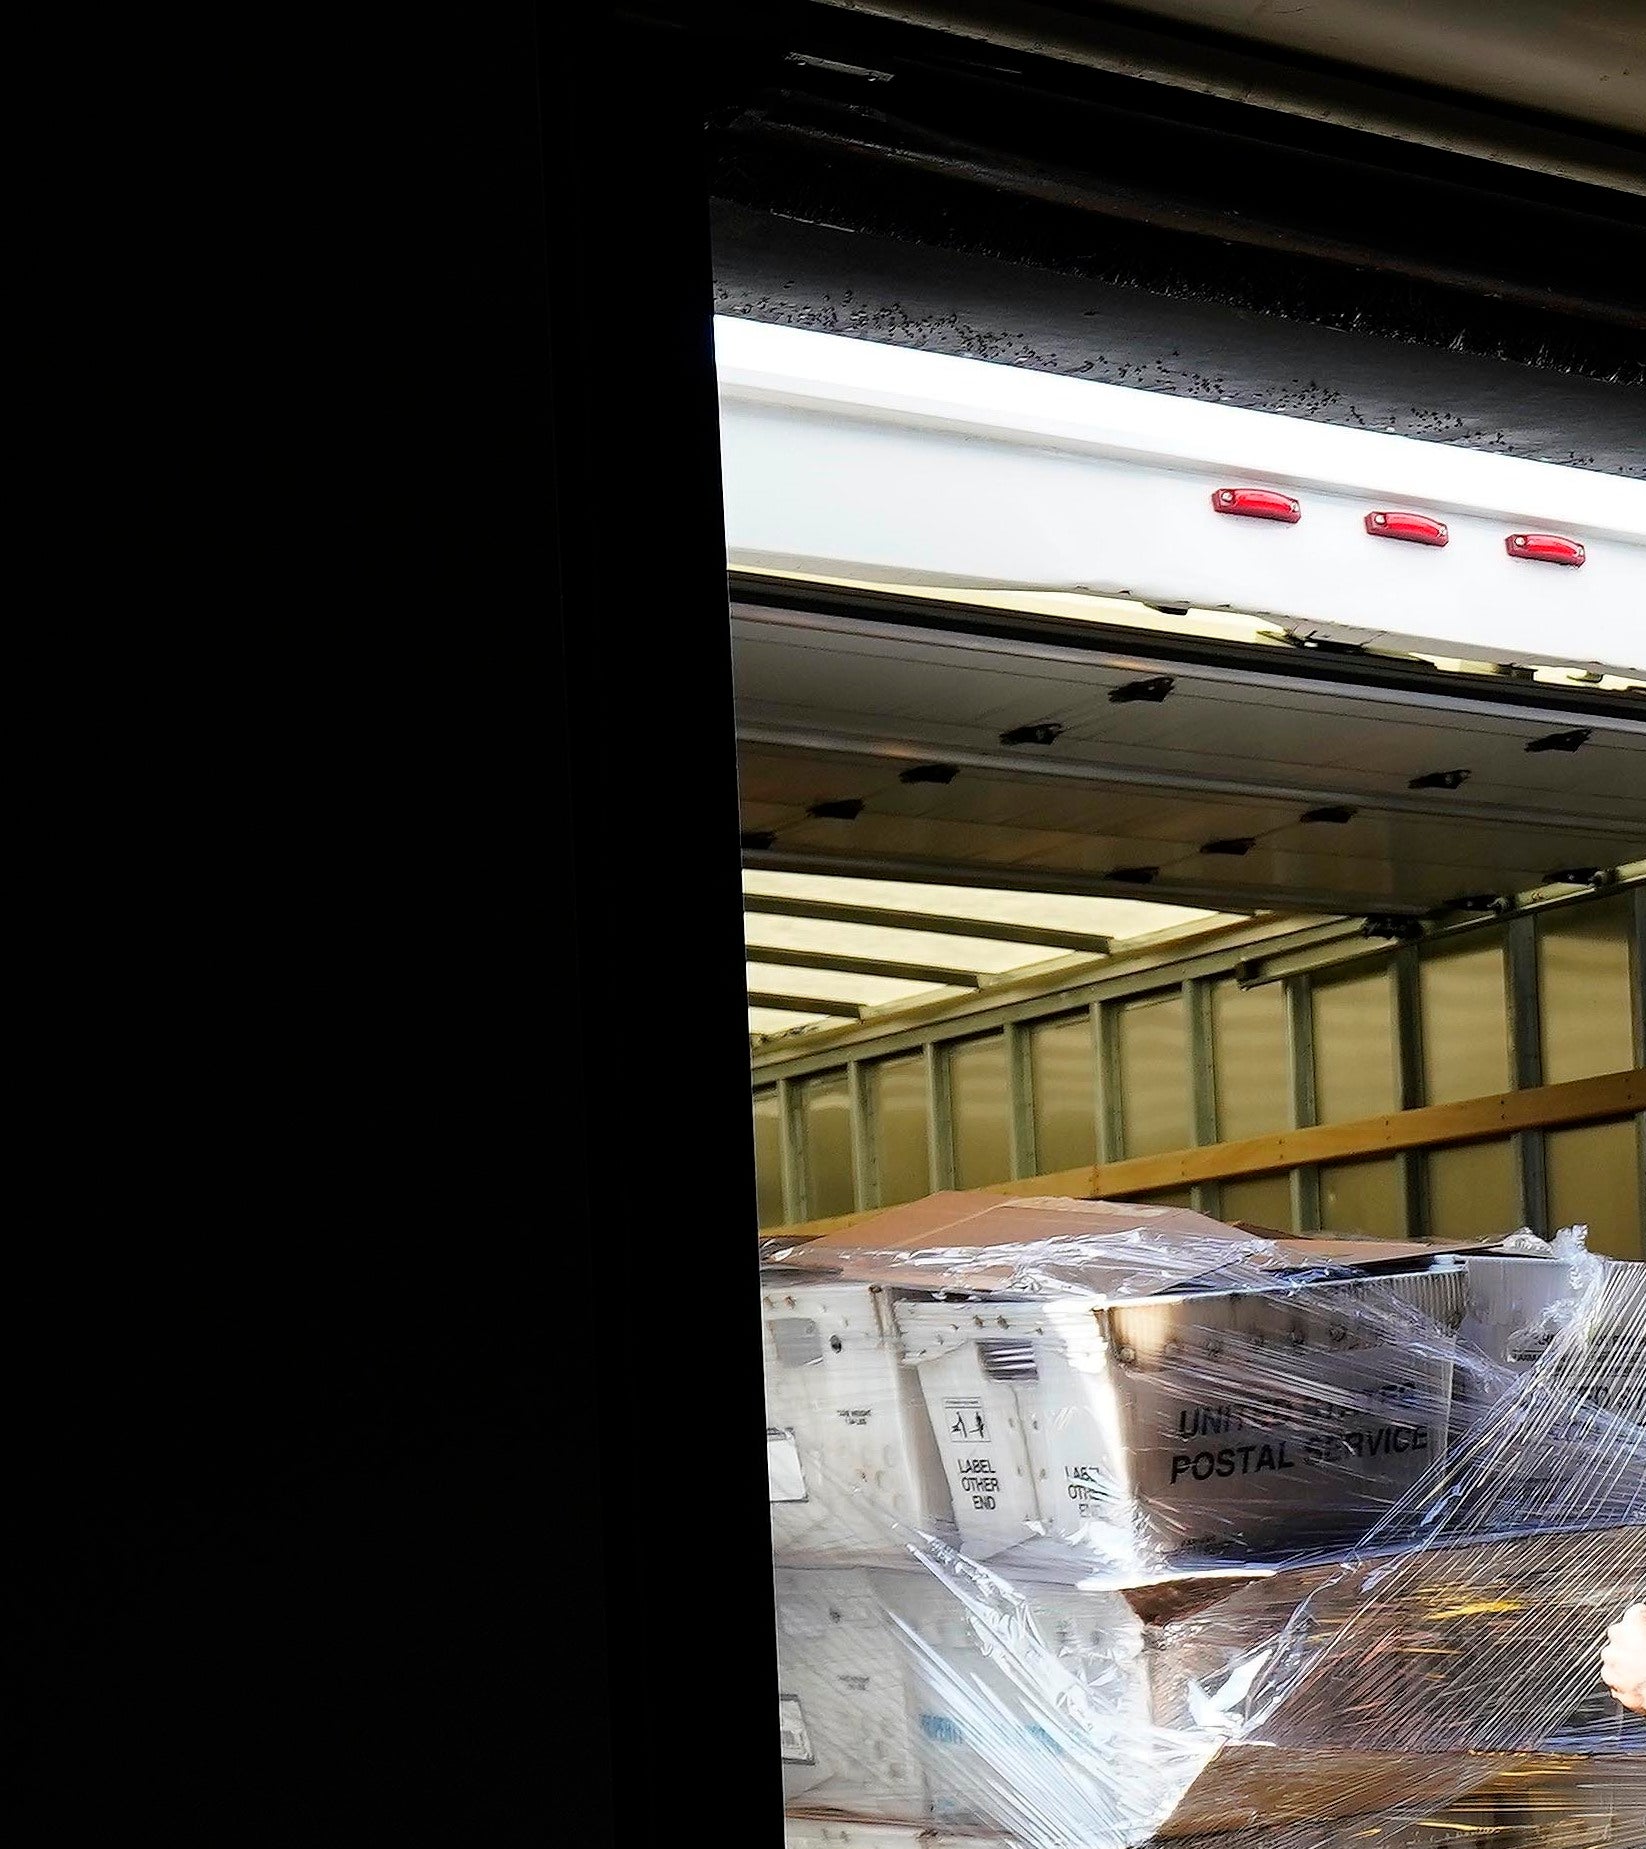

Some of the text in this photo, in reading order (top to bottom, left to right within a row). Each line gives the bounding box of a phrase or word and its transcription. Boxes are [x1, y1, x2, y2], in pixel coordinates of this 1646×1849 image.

[957, 1459, 997, 1474] LABEL
[1170, 1441, 1295, 1485] POSTAL
[961, 1477, 1000, 1492] OTHER
[972, 1495, 996, 1510] END
